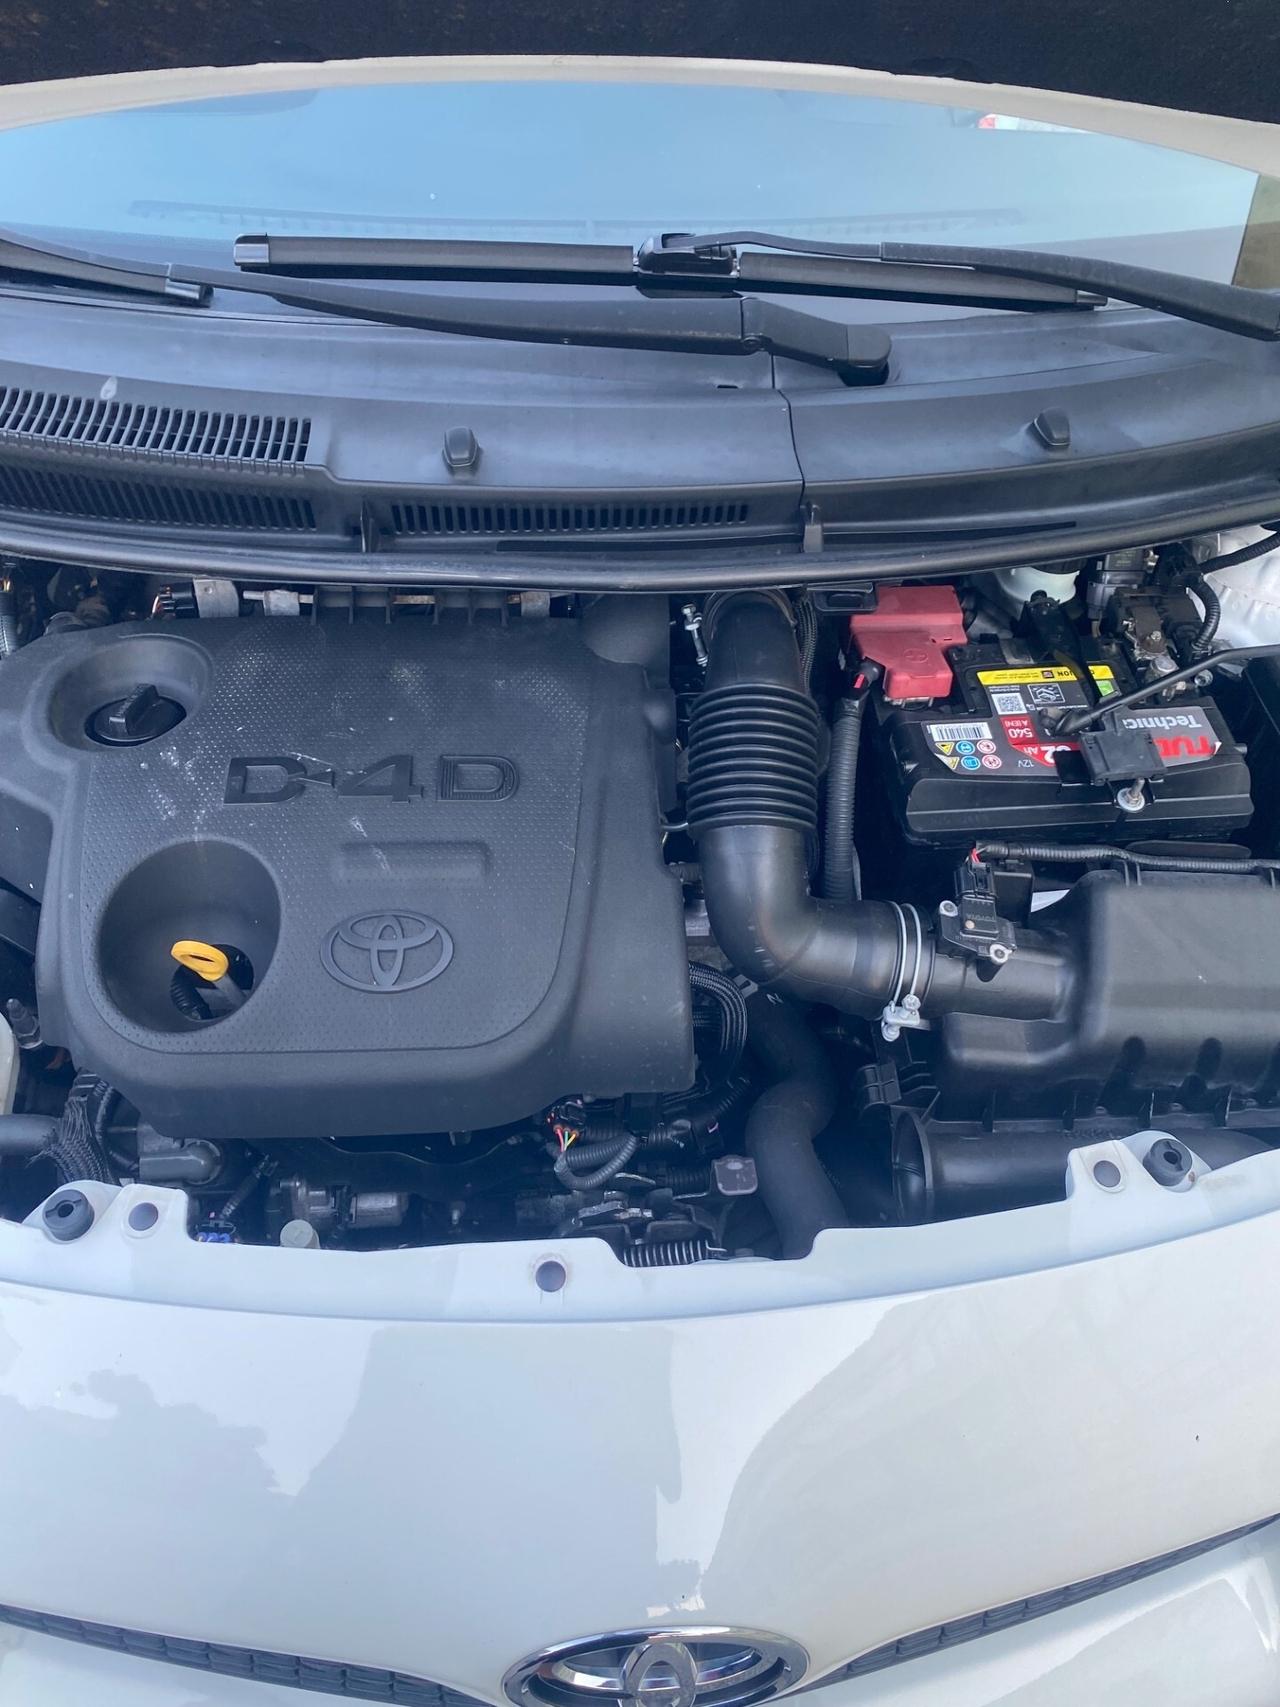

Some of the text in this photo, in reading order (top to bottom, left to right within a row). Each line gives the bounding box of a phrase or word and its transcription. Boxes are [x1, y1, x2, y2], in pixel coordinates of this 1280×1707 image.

[1008, 727, 1034, 739] 540
[1023, 745, 1039, 755] Ah
[1017, 759, 1035, 768] 12V
[222, 754, 520, 806] D-4D
